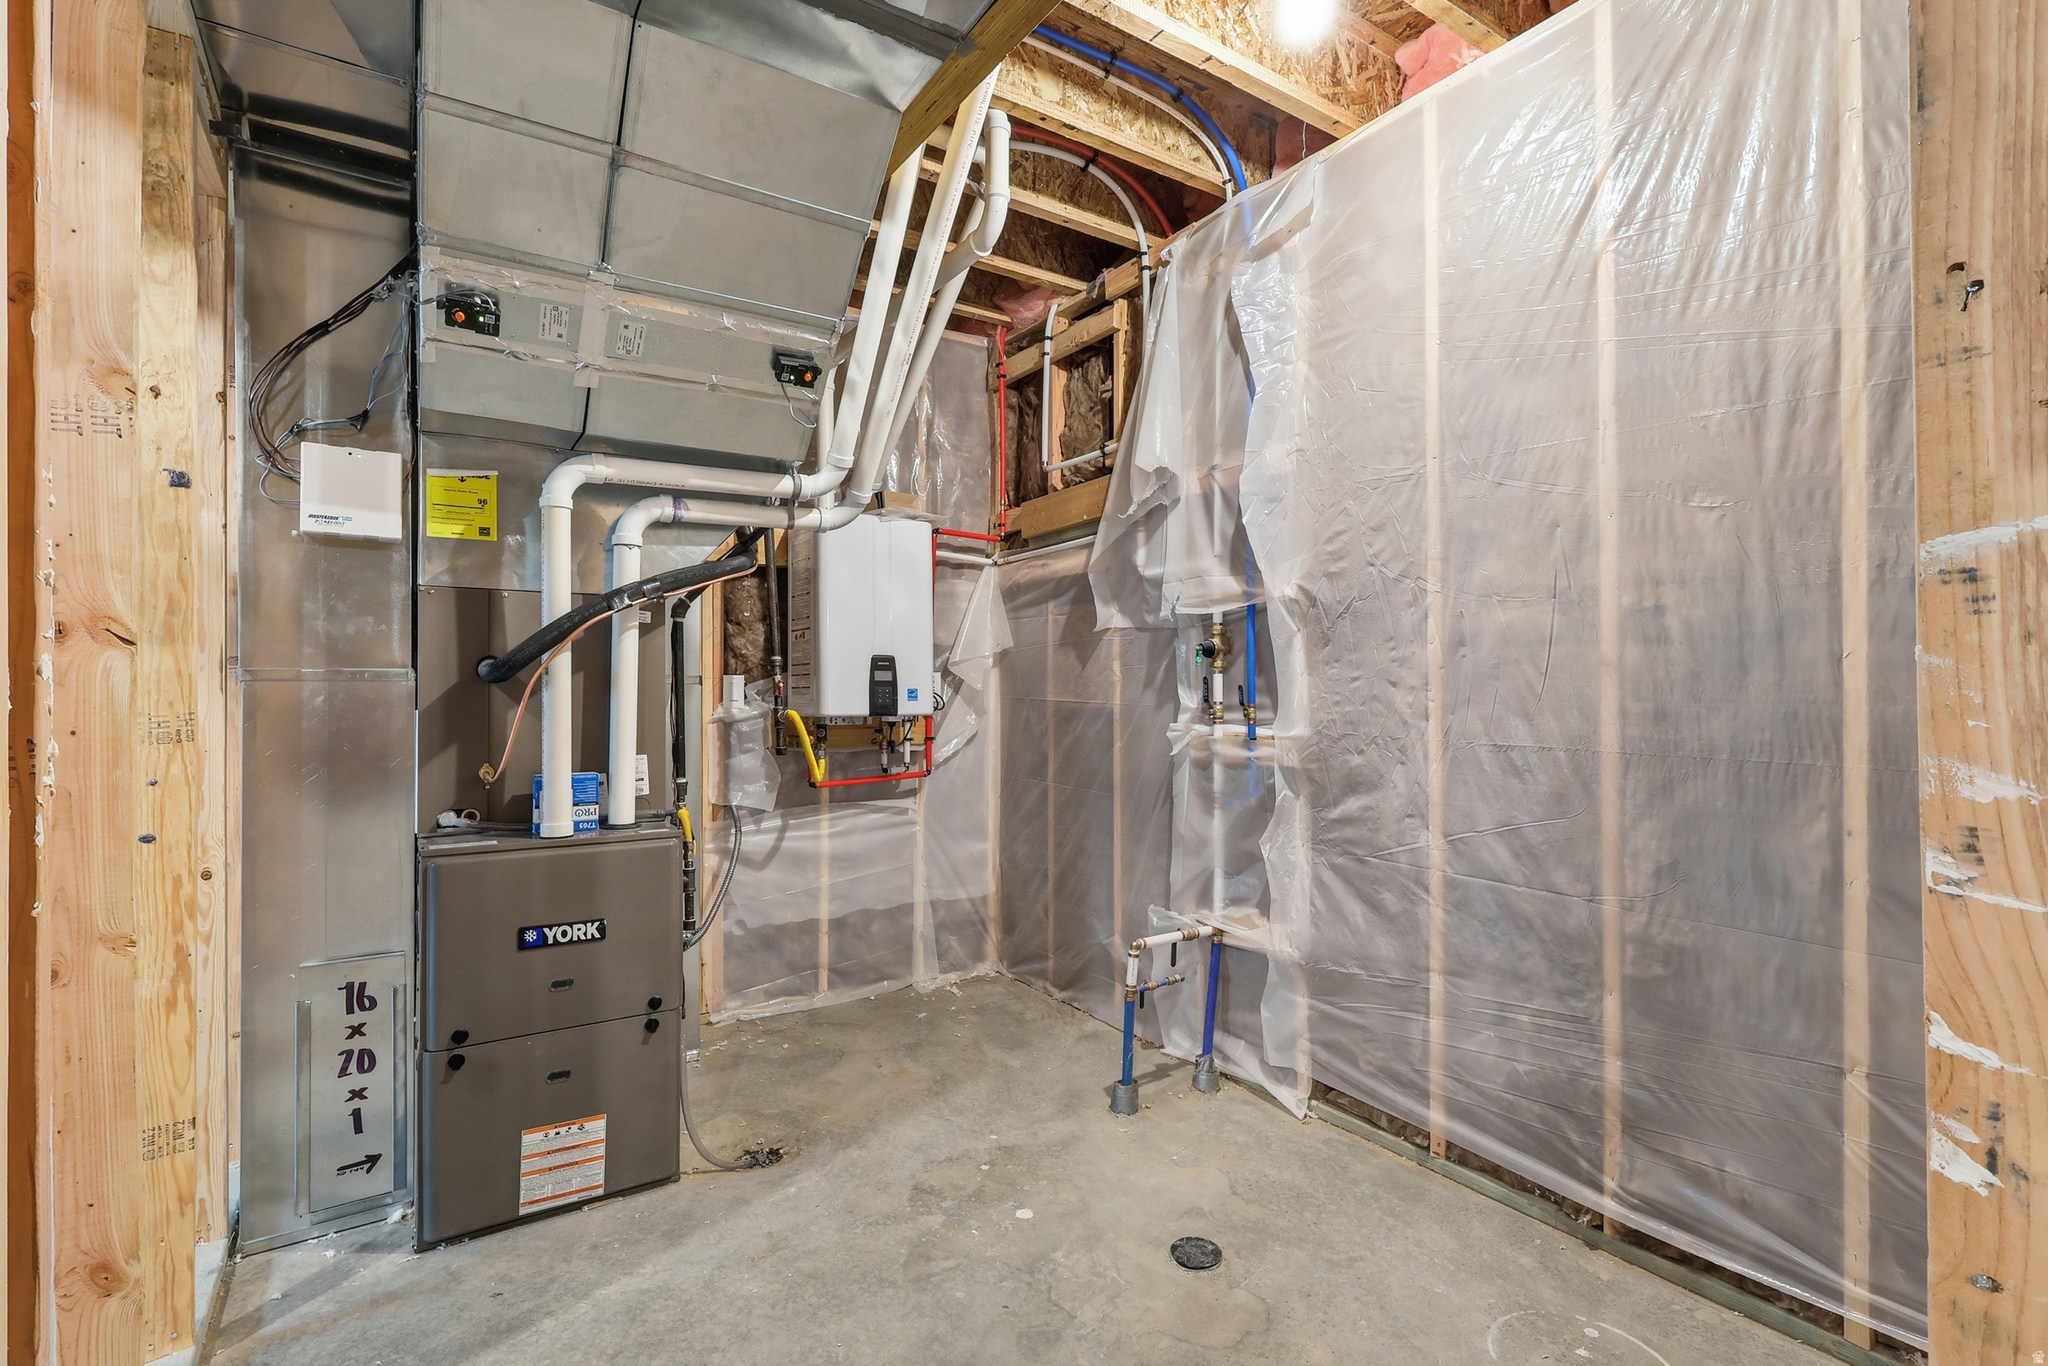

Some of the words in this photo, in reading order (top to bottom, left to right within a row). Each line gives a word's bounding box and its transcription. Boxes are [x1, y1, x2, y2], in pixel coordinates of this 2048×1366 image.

[477, 498, 488, 506] 96
[574, 807, 597, 818] PRO
[543, 921, 601, 945] YORK
[337, 981, 378, 1015] 16
[337, 1048, 377, 1079] 20
[348, 1107, 364, 1135] 1
